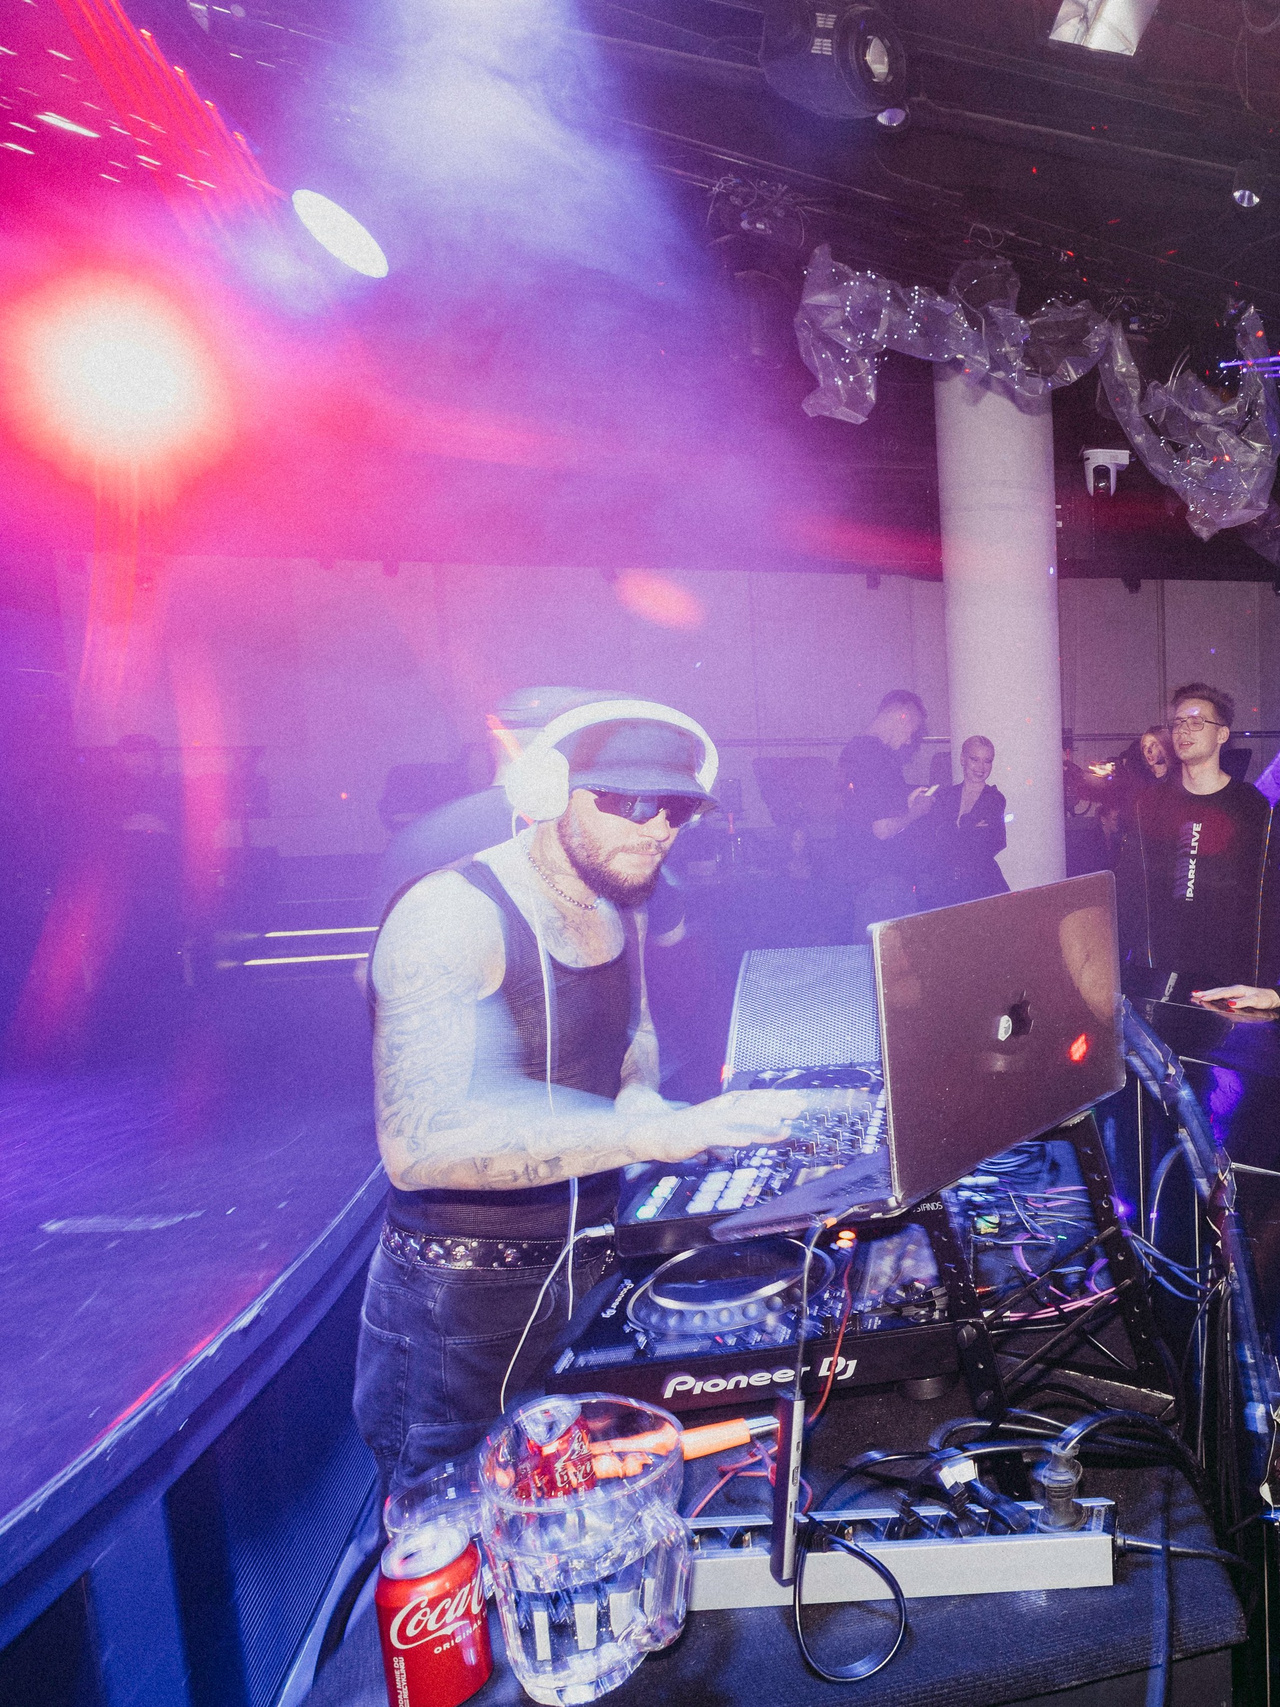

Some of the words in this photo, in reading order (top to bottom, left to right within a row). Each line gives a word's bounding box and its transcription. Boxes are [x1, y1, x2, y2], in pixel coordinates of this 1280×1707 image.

[1190, 823, 1202, 854] LIVE
[1186, 859, 1196, 898] PARK
[611, 1284, 634, 1309] Pioneer
[663, 1366, 811, 1399] Pioneer
[433, 1619, 482, 1654] ORIGINAL
[392, 1656, 399, 1669] DO
[398, 1656, 408, 1698] RECYKLINGU
[394, 1669, 402, 1689] MNIE
